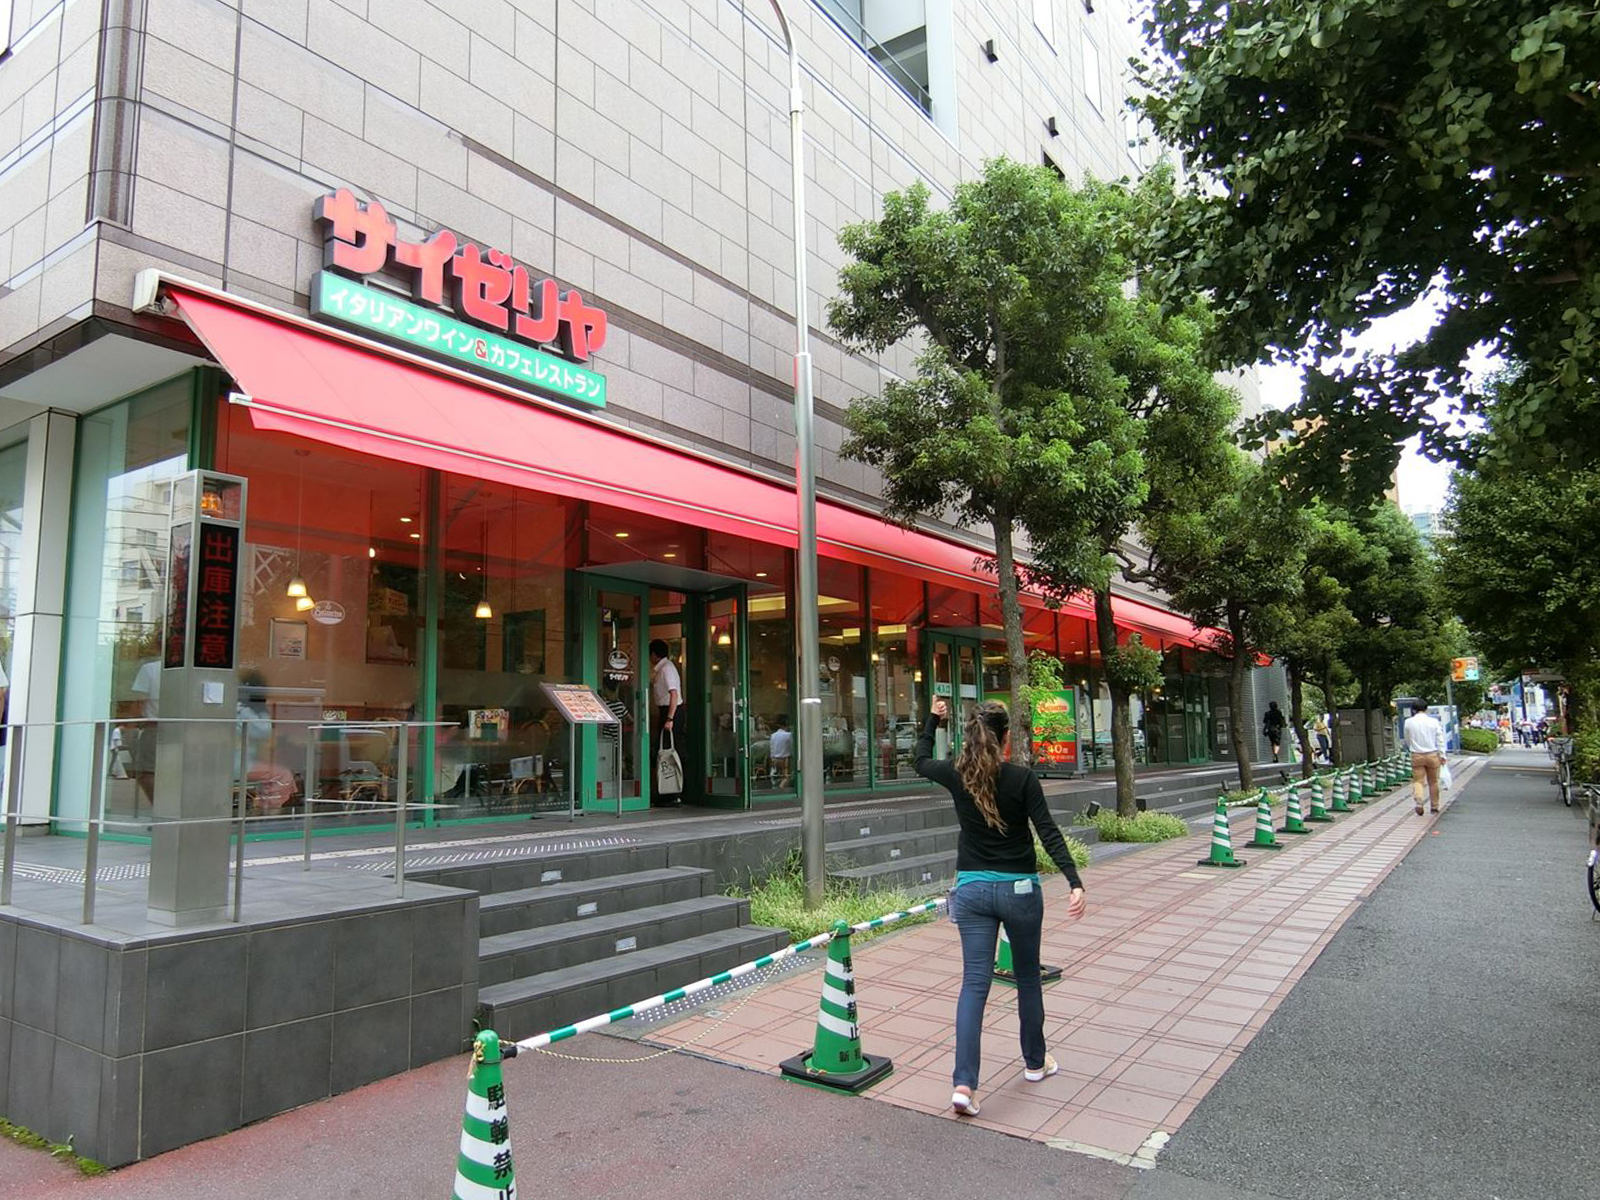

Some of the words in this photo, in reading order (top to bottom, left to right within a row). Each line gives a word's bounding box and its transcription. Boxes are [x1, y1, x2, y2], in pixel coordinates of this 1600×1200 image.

[323, 188, 607, 361] サイゼリヤ
[329, 288, 600, 397] イタリアンワイン&カフェレストラン
[200, 531, 233, 664] 出庫注意
